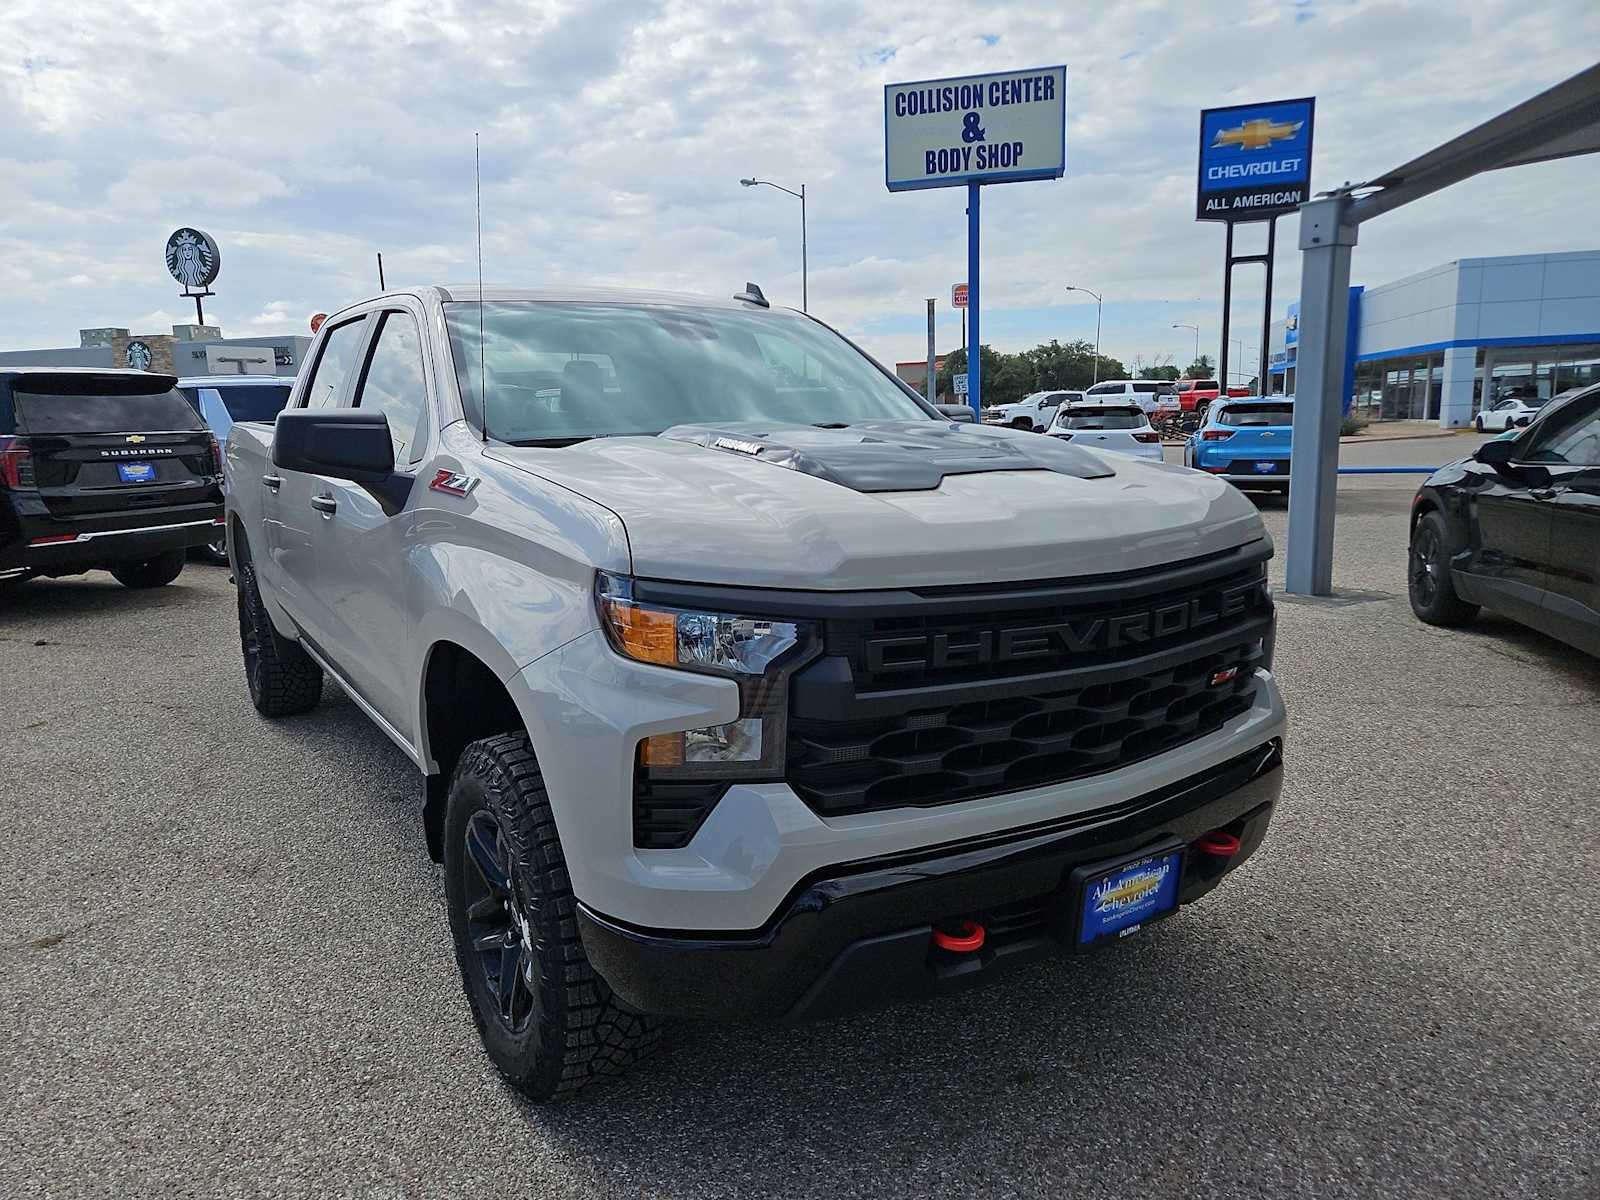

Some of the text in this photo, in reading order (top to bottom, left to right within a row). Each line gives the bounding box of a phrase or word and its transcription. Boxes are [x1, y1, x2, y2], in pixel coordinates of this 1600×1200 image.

[895, 75, 1055, 118] COLLISION CENTER
[961, 111, 986, 143] &
[925, 141, 1024, 175] BODY SHOP
[1208, 158, 1302, 180] CHEVROLET
[1205, 190, 1302, 211] ALL AMERICAN
[954, 295, 968, 303] KIN
[100, 448, 174, 457] SUBURBAN
[429, 467, 481, 499] Z71
[1101, 882, 1160, 913] Chevrolet
